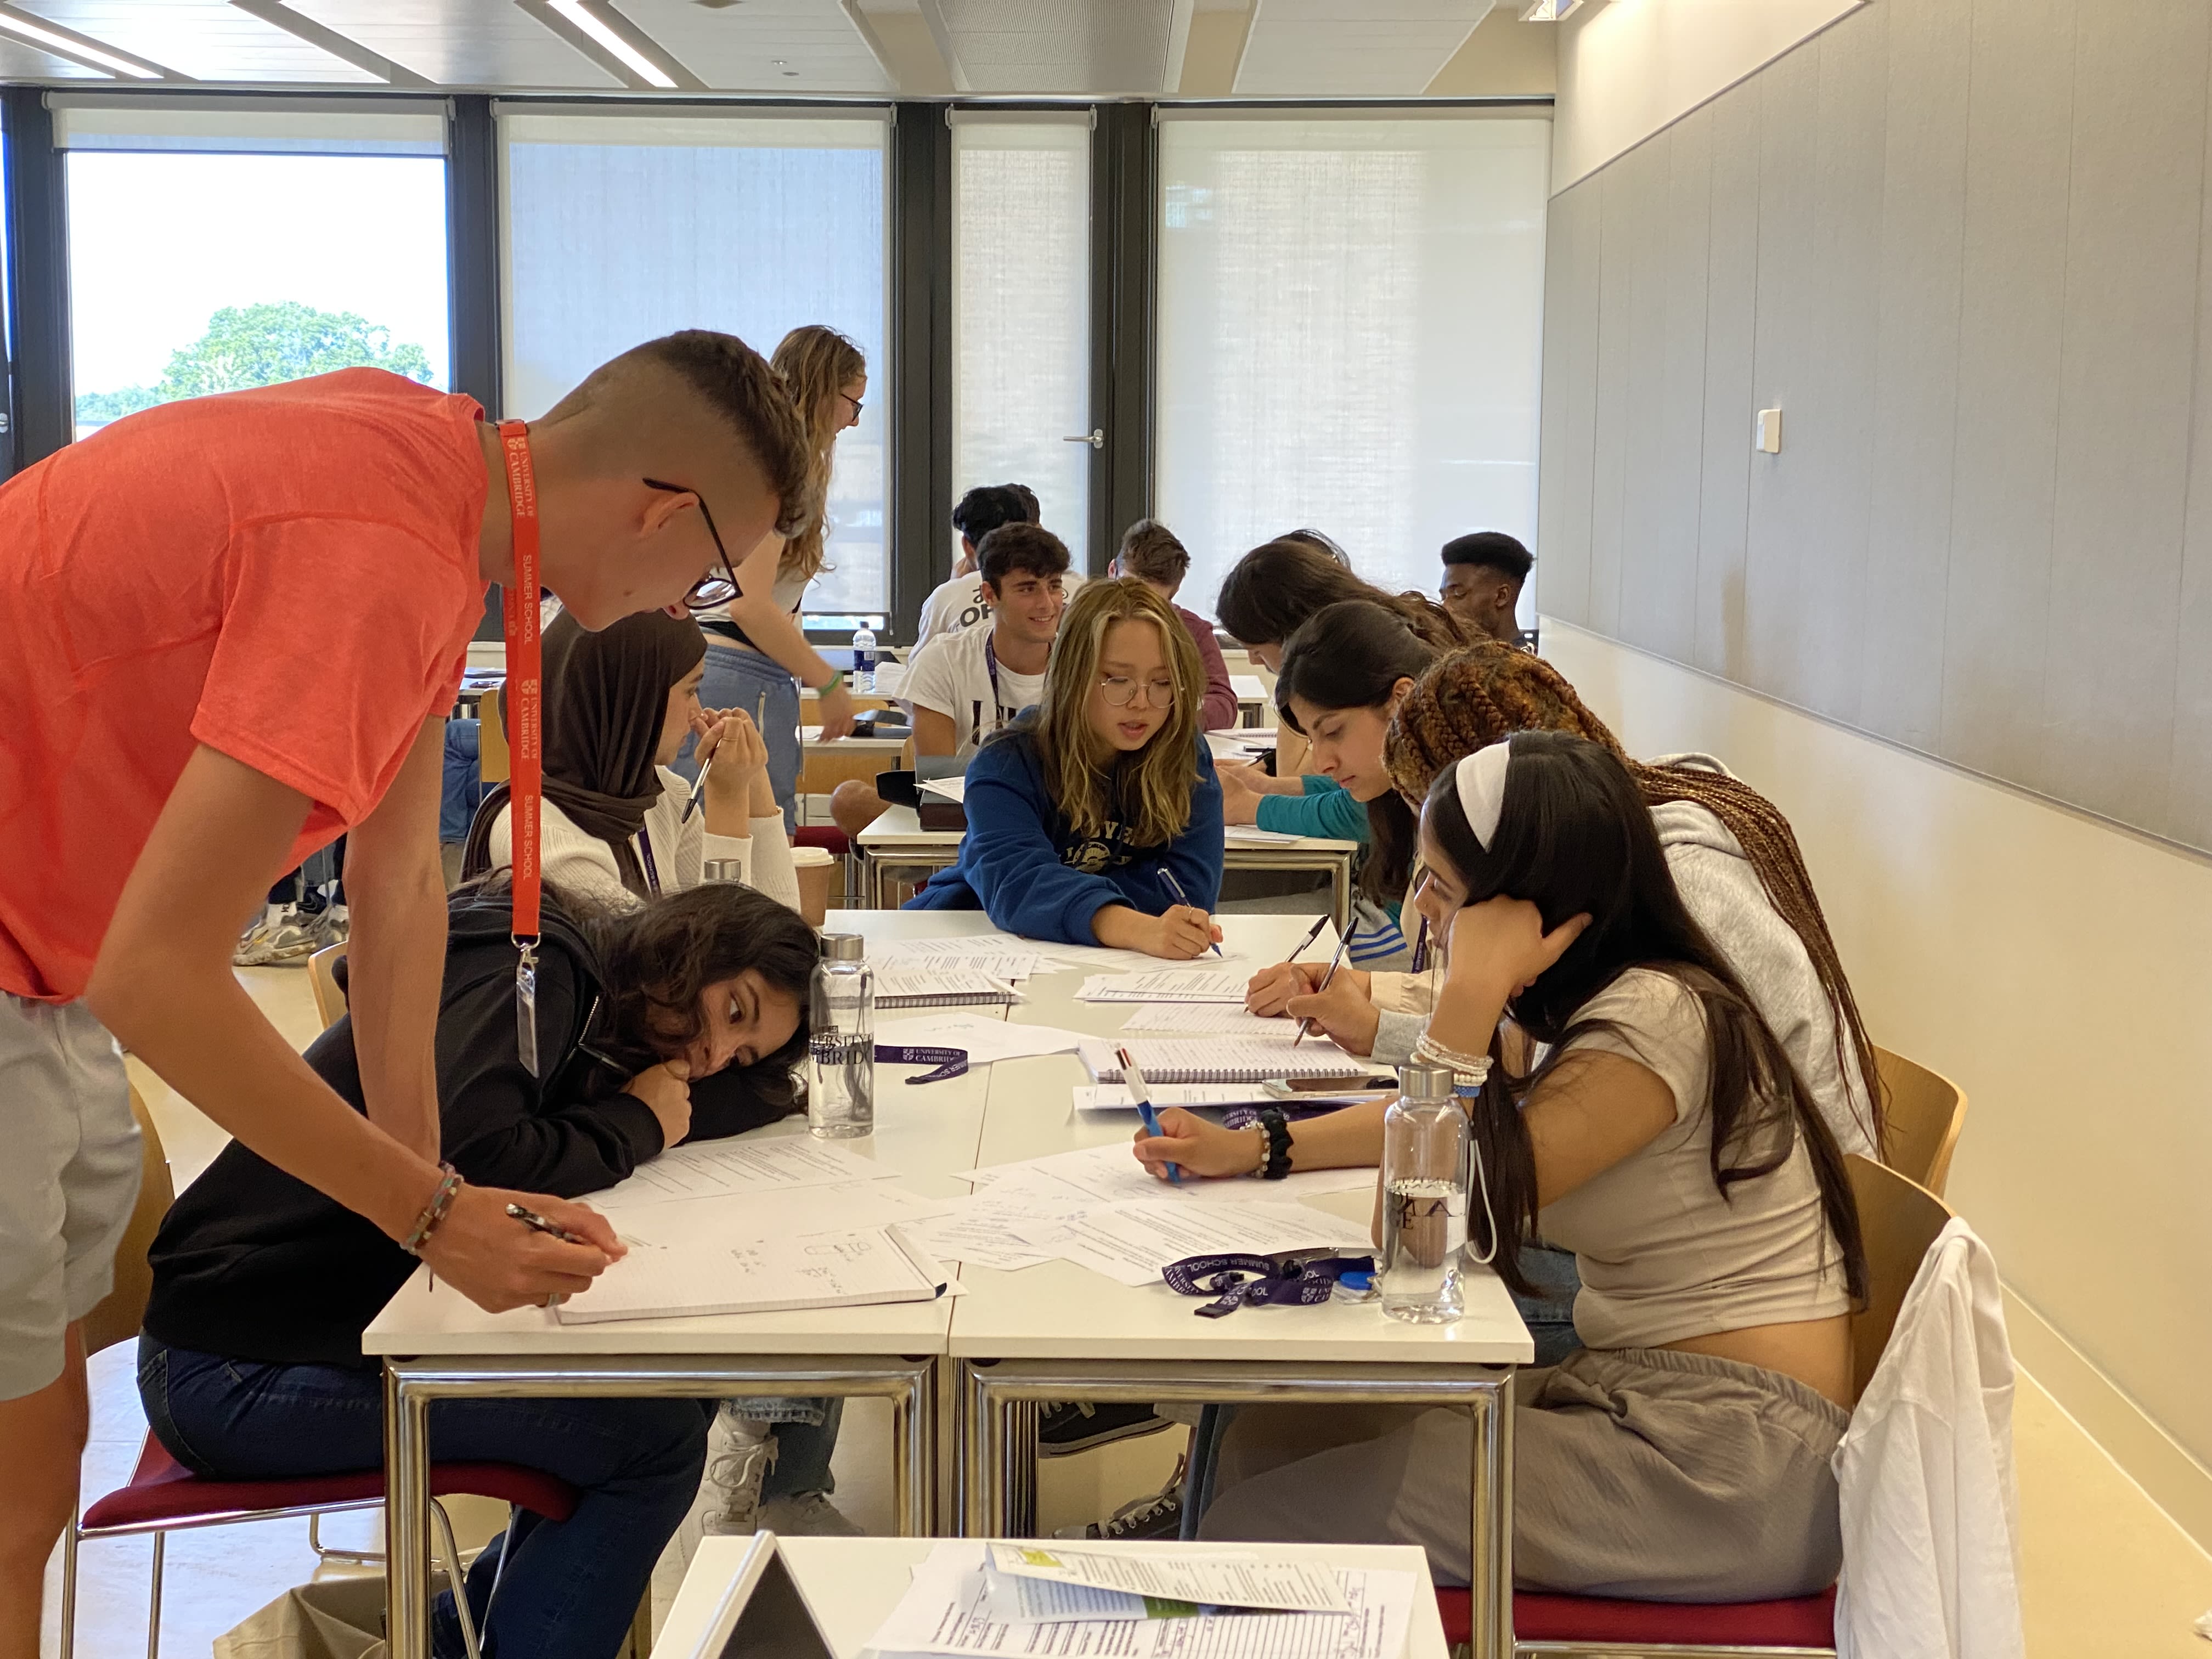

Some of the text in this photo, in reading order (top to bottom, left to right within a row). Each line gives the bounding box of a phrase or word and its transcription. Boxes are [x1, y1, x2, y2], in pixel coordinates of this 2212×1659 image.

[509, 452, 525, 518] CAMBRIDGE
[520, 451, 534, 518] UNIVERSITY OF
[523, 555, 533, 645] SUMMER SCHOOL
[521, 697, 529, 760] CAMBRIDGE
[531, 749, 538, 759] OF
[523, 794, 533, 881] SUMMER SCHOOL
[1187, 1258, 1269, 1272] SUMMER SCHOOL
